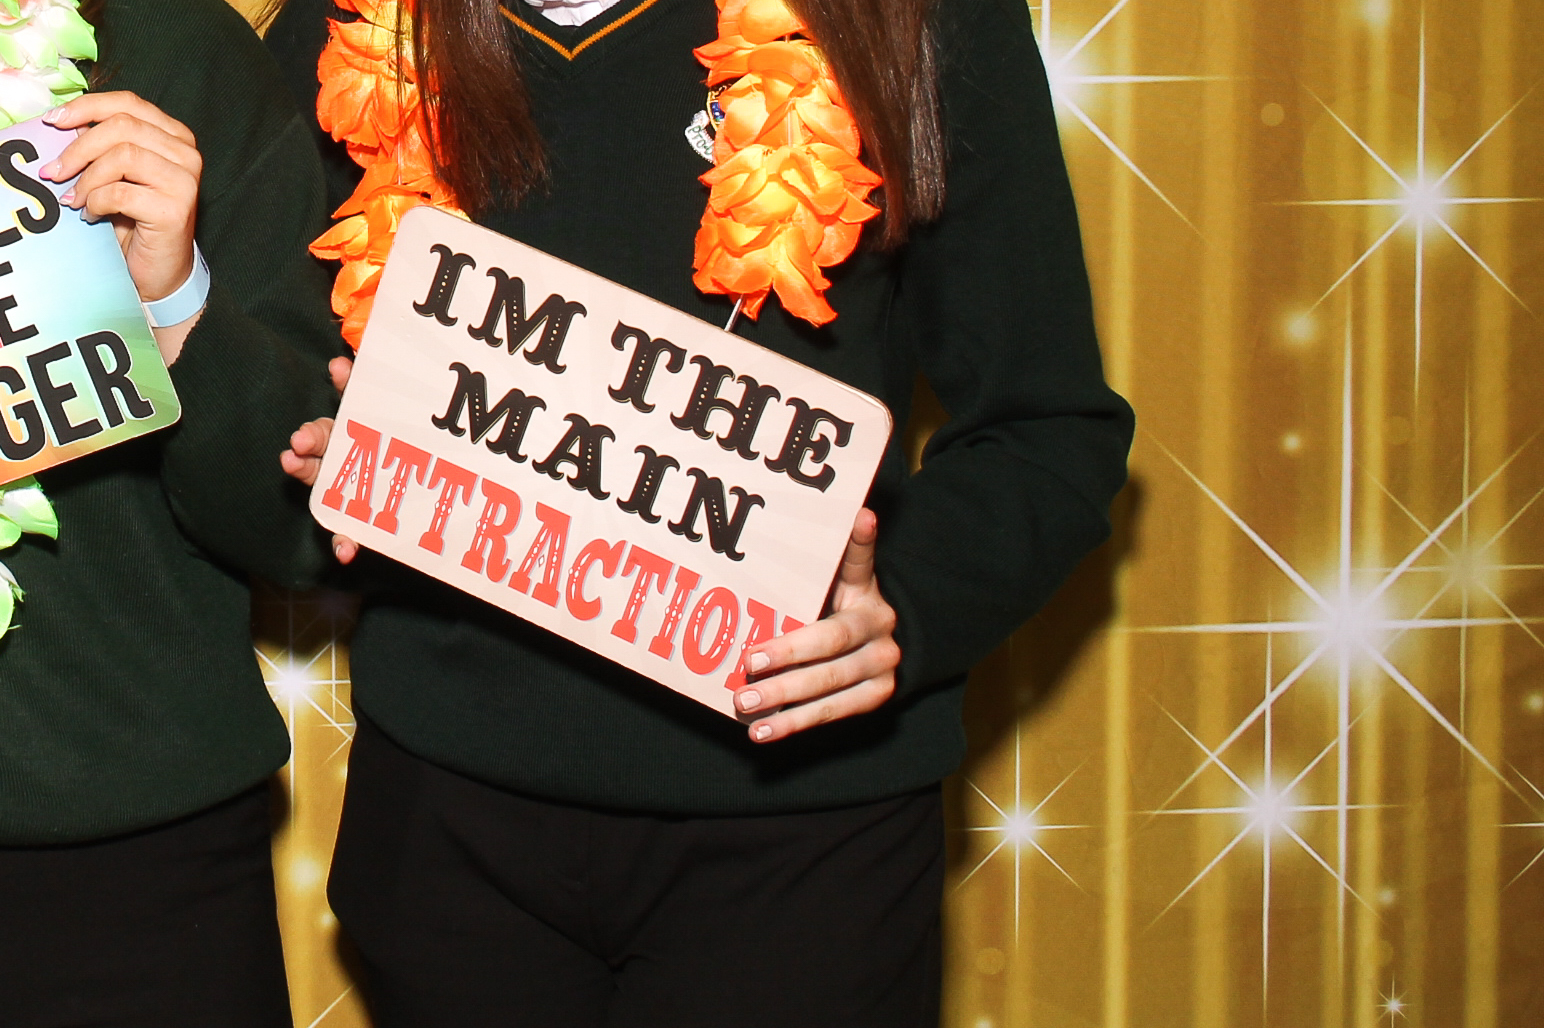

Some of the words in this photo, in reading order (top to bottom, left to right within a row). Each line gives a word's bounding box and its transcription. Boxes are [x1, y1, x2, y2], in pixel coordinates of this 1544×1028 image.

[413, 243, 588, 374] IM
[607, 319, 855, 494] THE
[431, 362, 766, 562] MAIN
